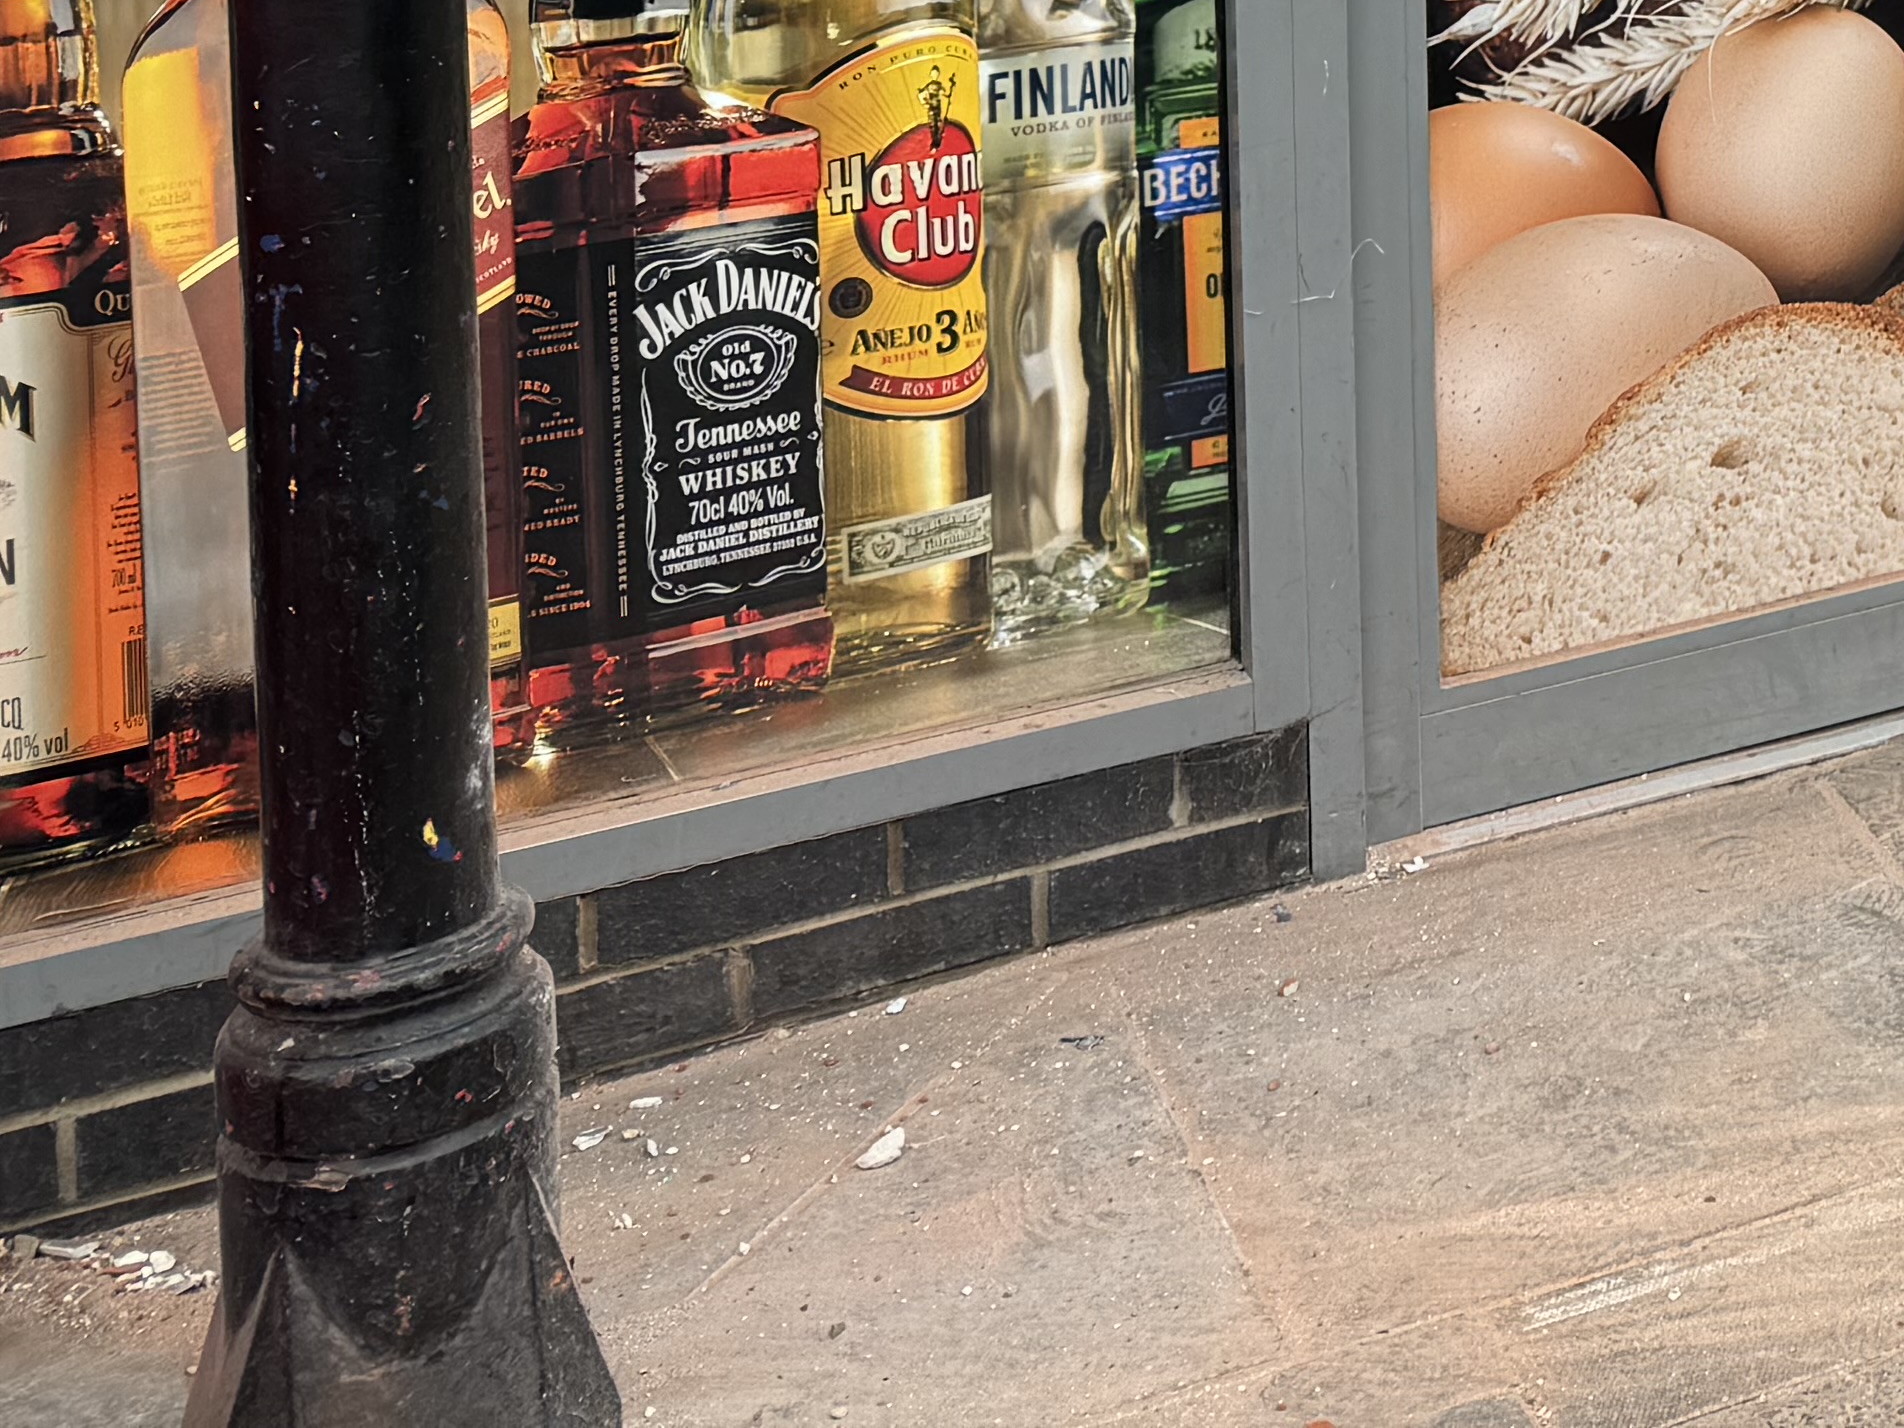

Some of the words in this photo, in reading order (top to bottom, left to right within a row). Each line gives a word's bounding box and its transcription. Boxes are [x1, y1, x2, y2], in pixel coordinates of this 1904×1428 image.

[837, 63, 879, 91] RON
[889, 45, 938, 65] PURO
[1010, 119, 1070, 137] VODKA
[1075, 116, 1096, 130] OF
[824, 148, 983, 216] Havan
[880, 199, 977, 265] Club
[607, 290, 619, 338] EVERY
[632, 276, 718, 360] JACK
[714, 258, 822, 332] DANIEL'S
[526, 341, 581, 358] CHARCOAL
[609, 337, 620, 372] DROP
[721, 340, 751, 356] Old
[849, 322, 933, 357] AÑEJO
[934, 308, 963, 357] 3
[610, 374, 622, 412] MADE
[869, 376, 892, 396] EL
[900, 376, 935, 398] RON
[941, 373, 961, 395] DE
[535, 426, 585, 444] BARRELS
[612, 415, 623, 429] IN
[674, 410, 801, 454] Tennessee
[612, 432, 625, 512] LYNCHBURG
[677, 451, 801, 497] WHISKEY
[707, 448, 739, 464] SOUR
[742, 442, 775, 457] MASH
[688, 495, 725, 526] 70cl
[727, 486, 764, 517] 40%
[765, 481, 795, 509] Vol.
[658, 543, 697, 562] JACK
[697, 532, 747, 555] DANIEL
[748, 515, 821, 543] DISTILLERY
[675, 524, 727, 545] DISTILLED
[727, 520, 749, 534] AND
[749, 511, 793, 529] BOTTLED
[792, 507, 806, 518] BY
[616, 514, 628, 593] TENNESSEE
[1, 733, 40, 763] 40%
[43, 727, 69, 756] vol
